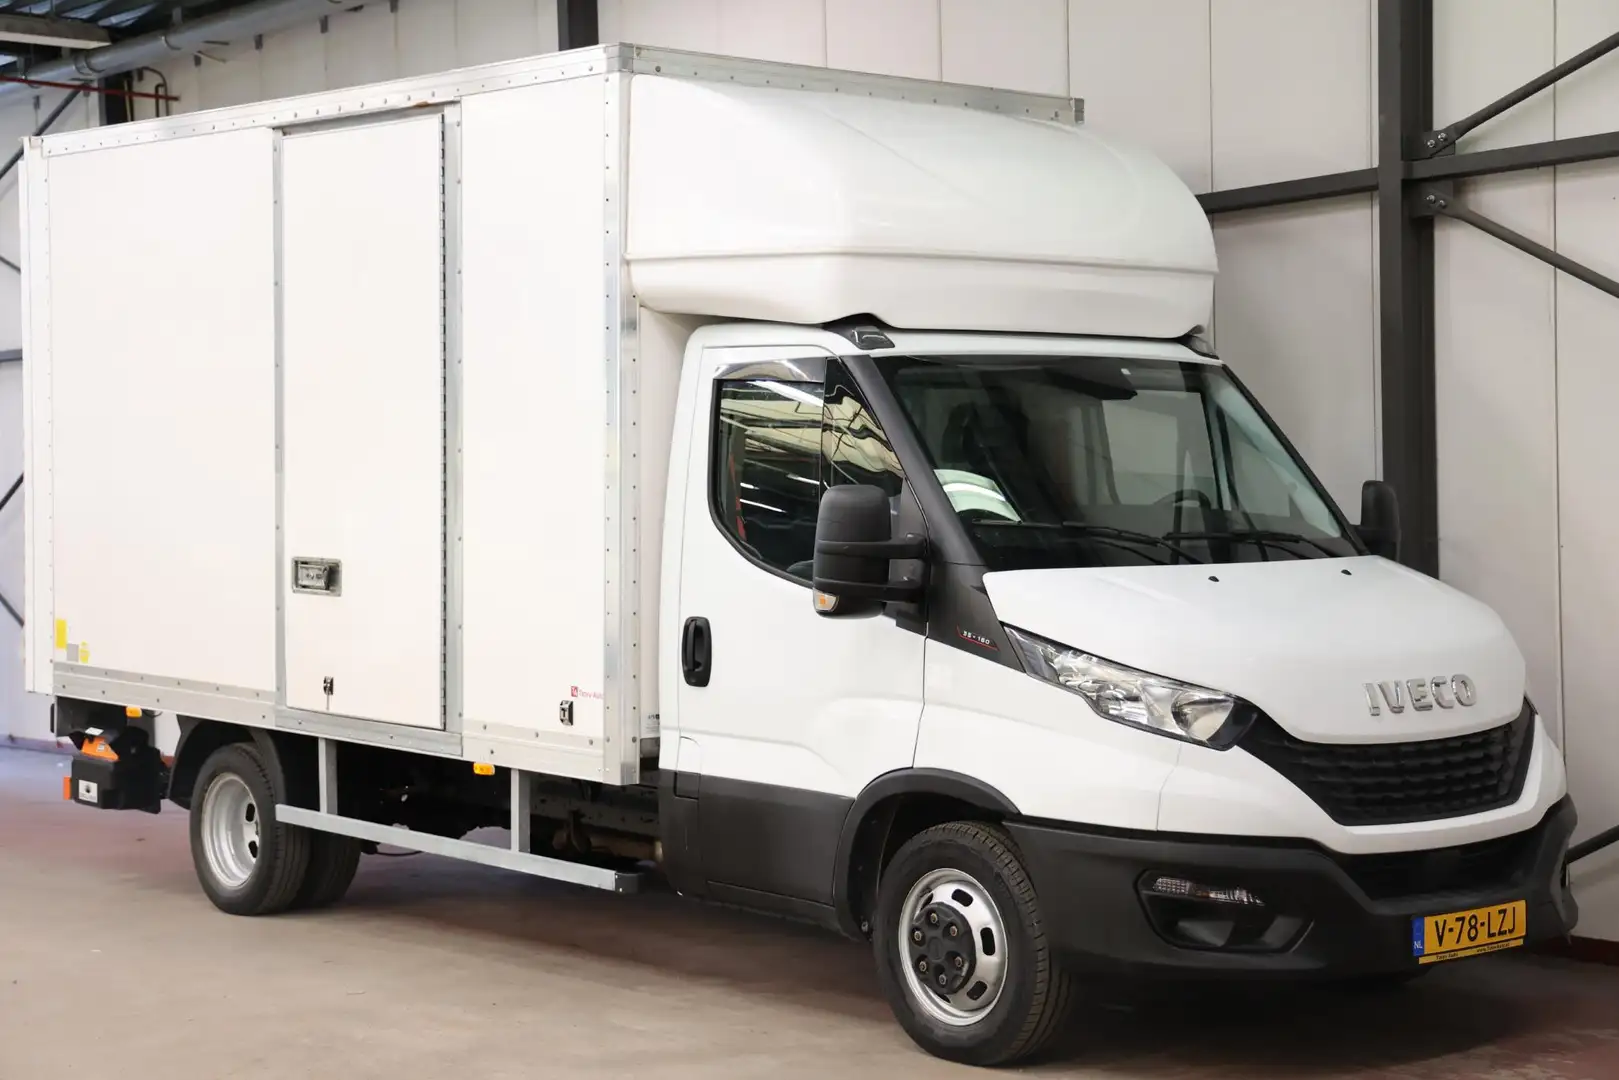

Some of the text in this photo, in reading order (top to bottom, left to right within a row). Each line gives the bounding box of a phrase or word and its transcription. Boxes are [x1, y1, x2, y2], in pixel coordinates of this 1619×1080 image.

[1362, 674, 1477, 716] IVECO
[1413, 941, 1423, 949] NL
[1434, 906, 1516, 947] V-78-LZJ
